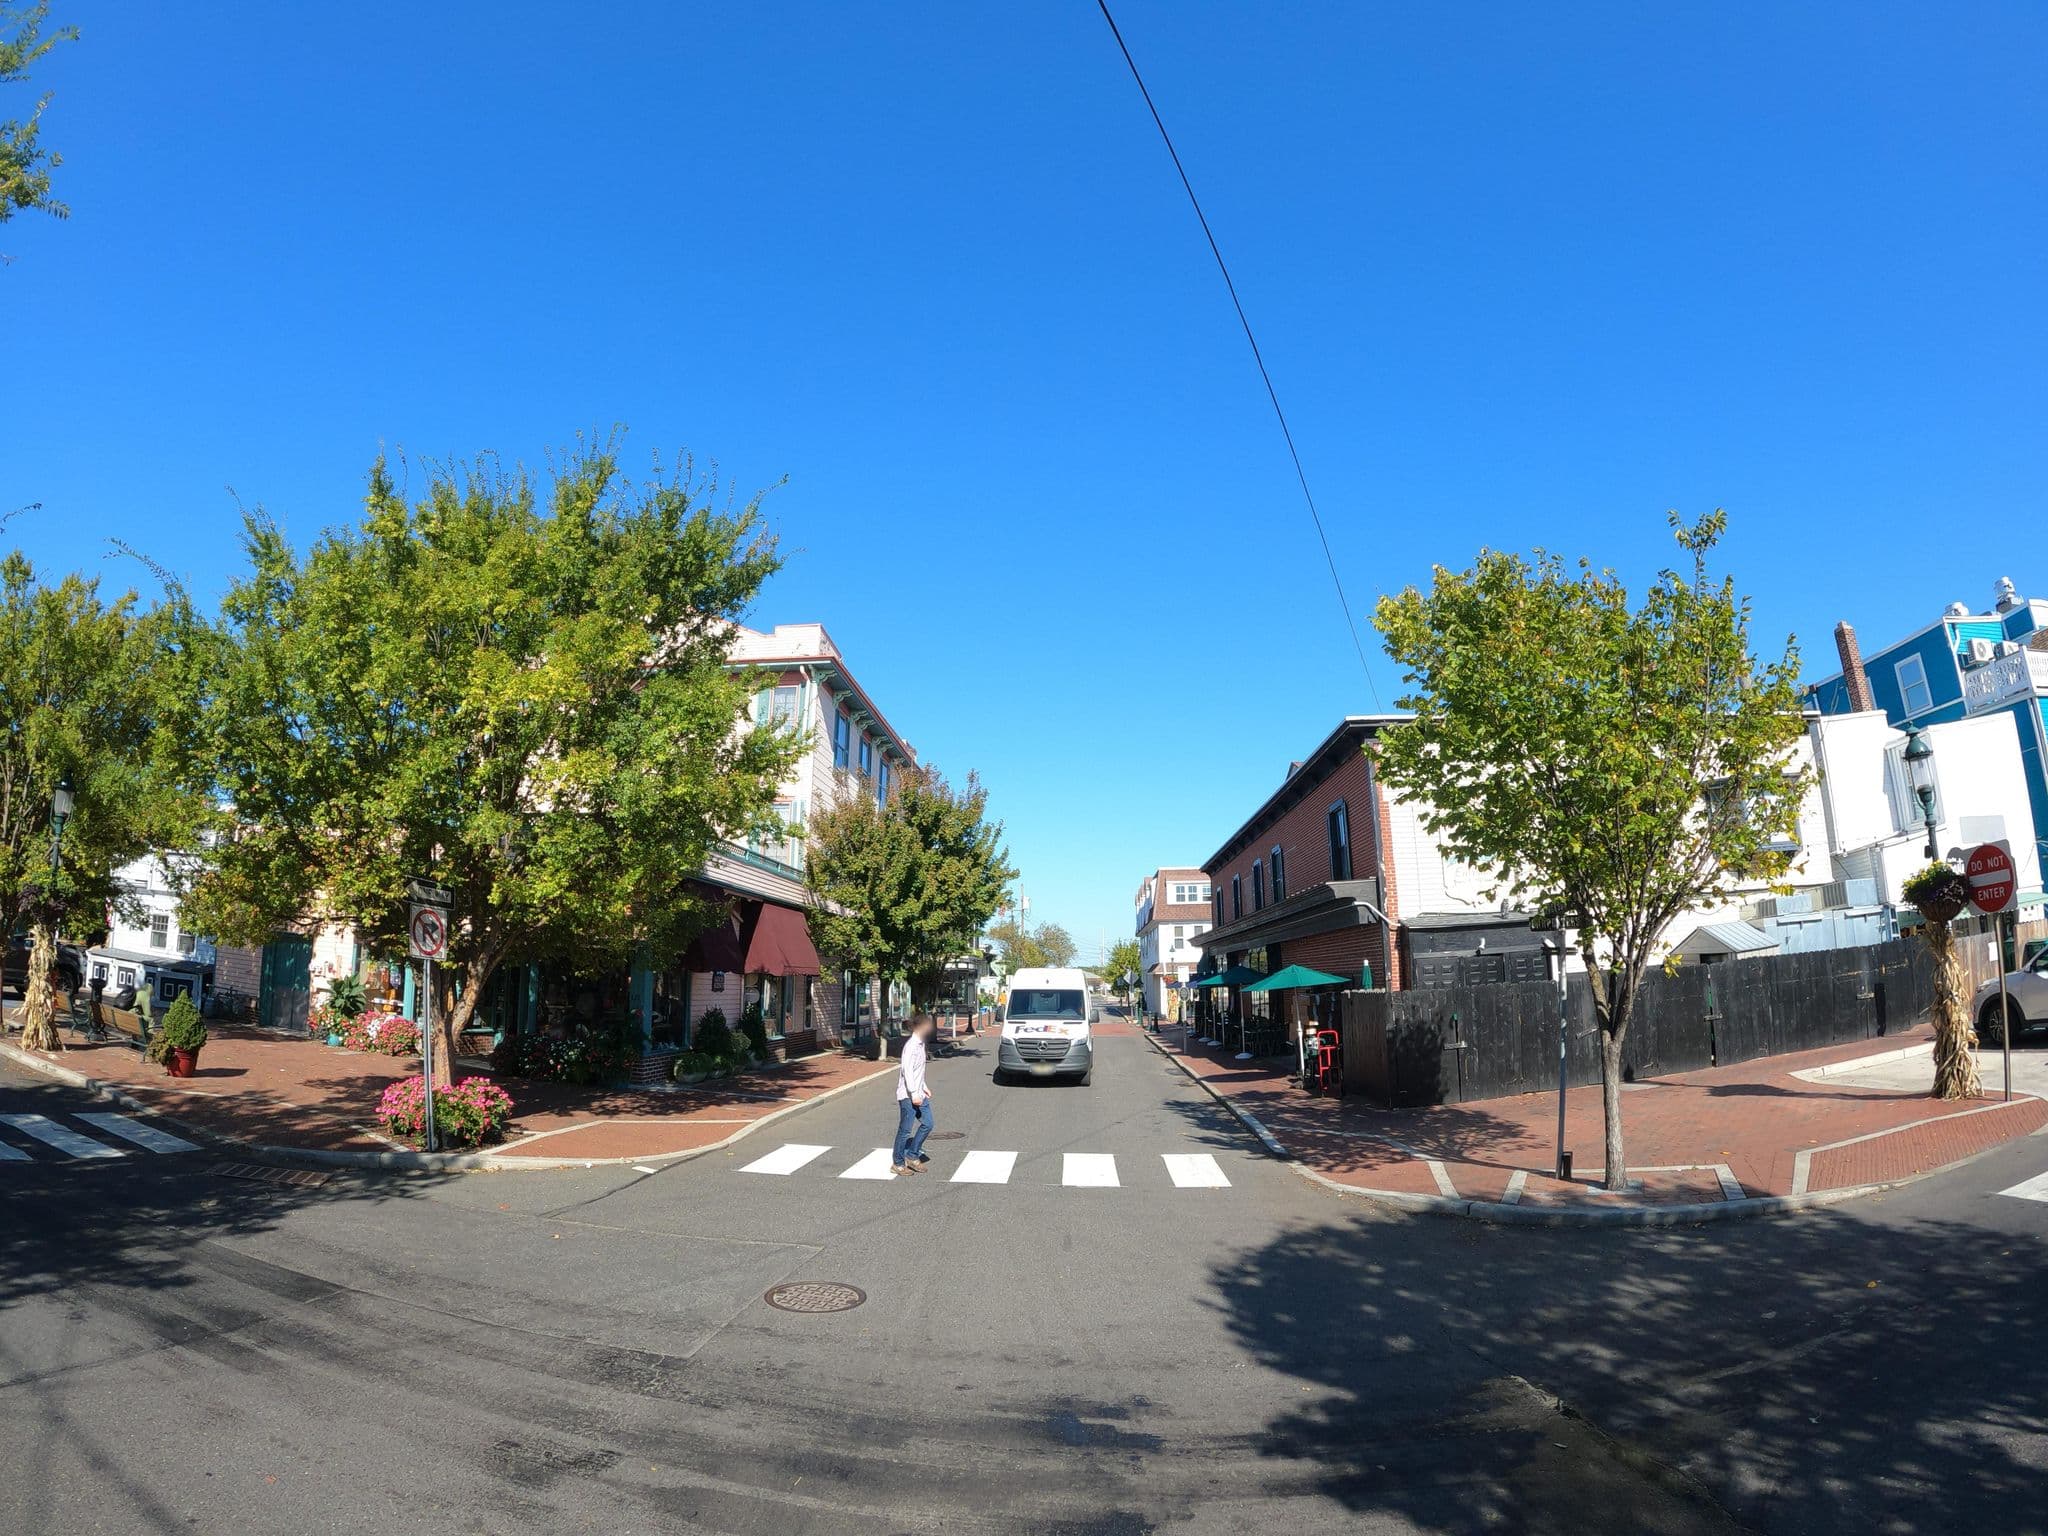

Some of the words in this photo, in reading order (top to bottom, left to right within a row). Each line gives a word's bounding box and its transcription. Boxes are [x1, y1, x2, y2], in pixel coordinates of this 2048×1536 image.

[1970, 860, 1983, 872] DO
[1987, 855, 2005, 869] NOT
[1977, 886, 2006, 901] ENTER
[1014, 1024, 1070, 1036] FedEx
